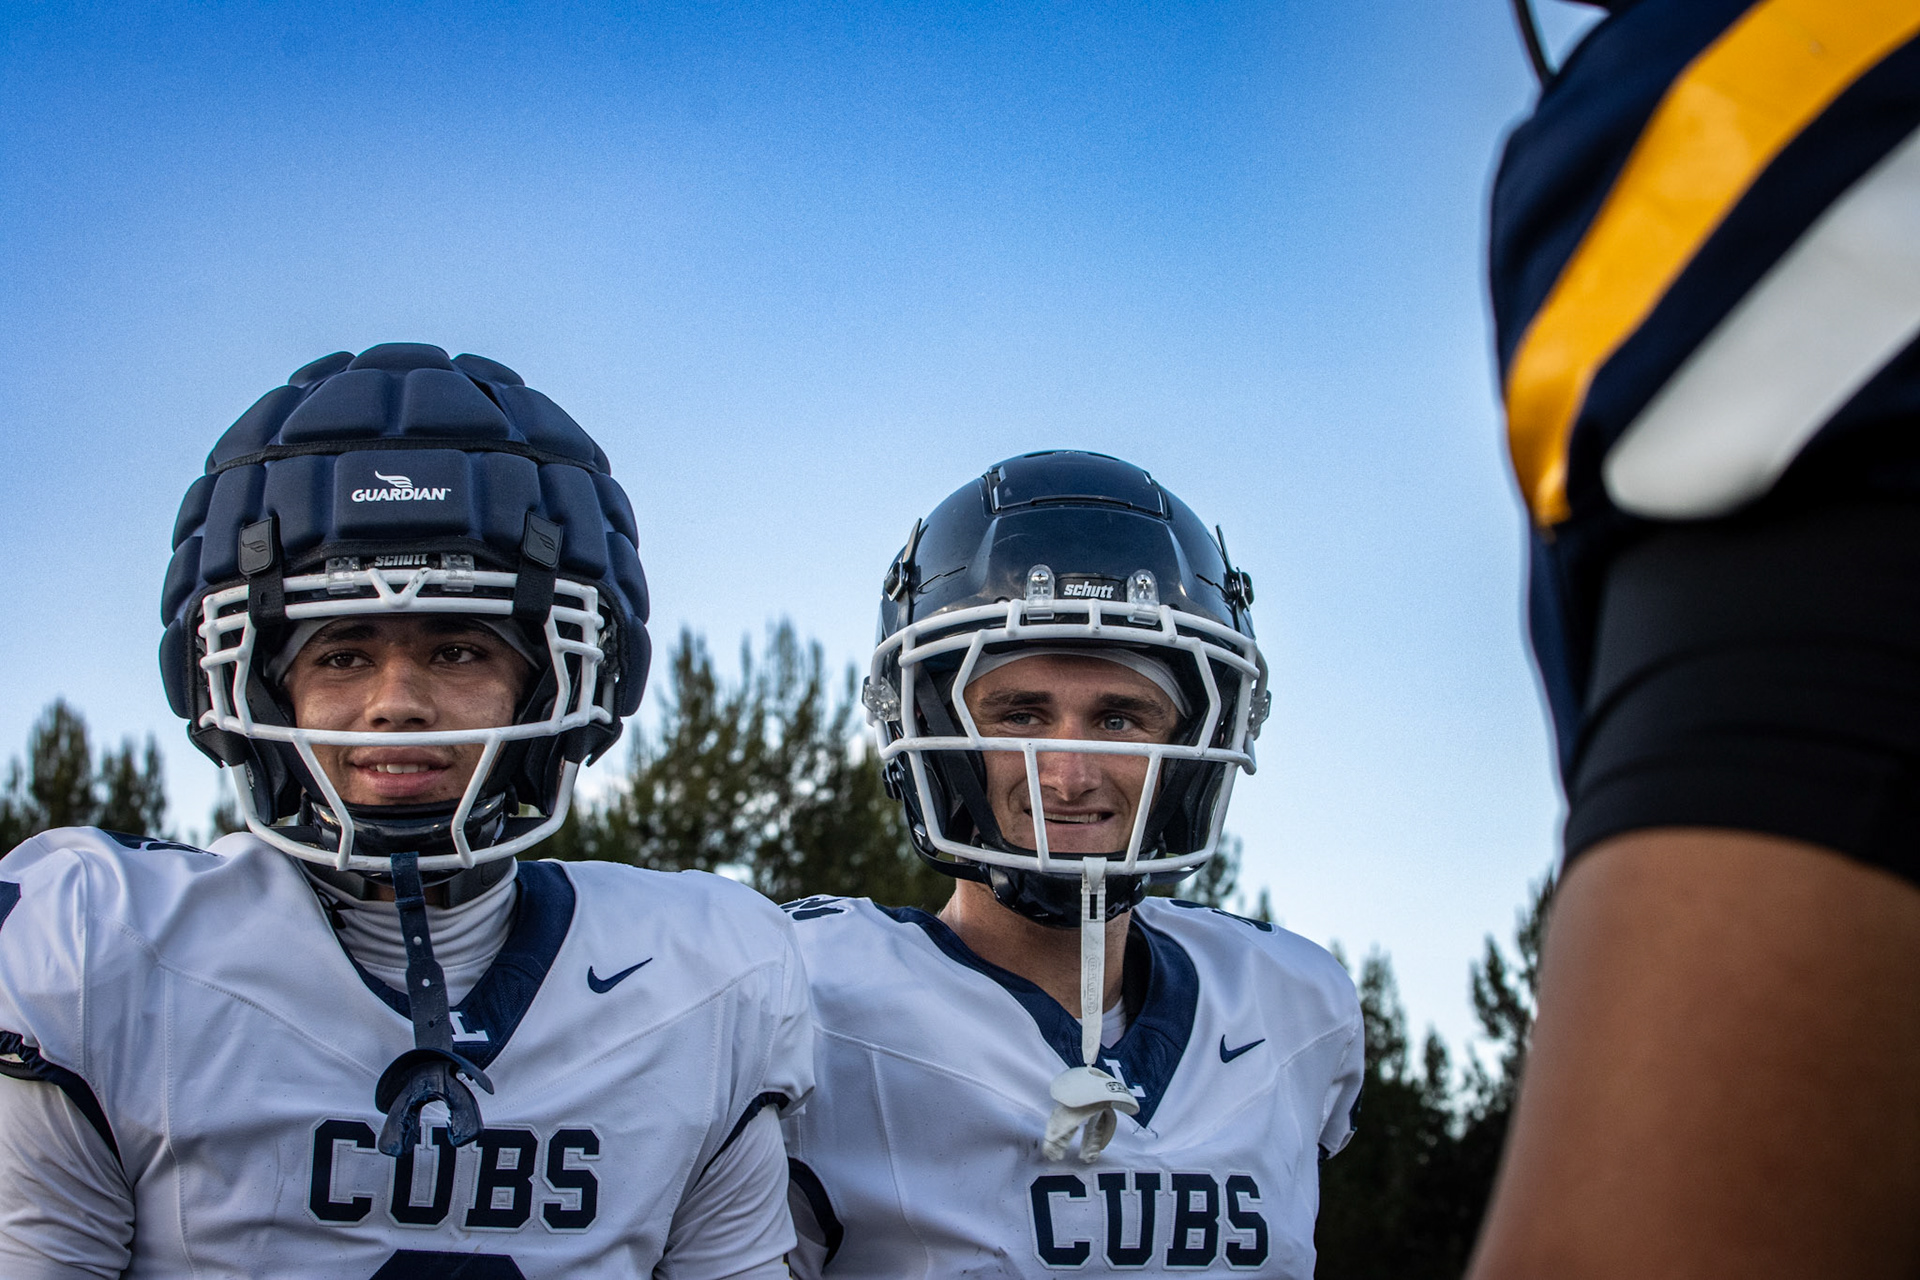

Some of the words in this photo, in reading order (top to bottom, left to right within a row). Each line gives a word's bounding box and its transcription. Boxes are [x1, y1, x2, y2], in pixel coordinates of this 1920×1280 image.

[351, 487, 446, 503] GUARDIAN
[1063, 581, 1114, 598] schutt
[307, 1117, 602, 1231] CUBS
[1029, 1171, 1270, 1268] CUBS
